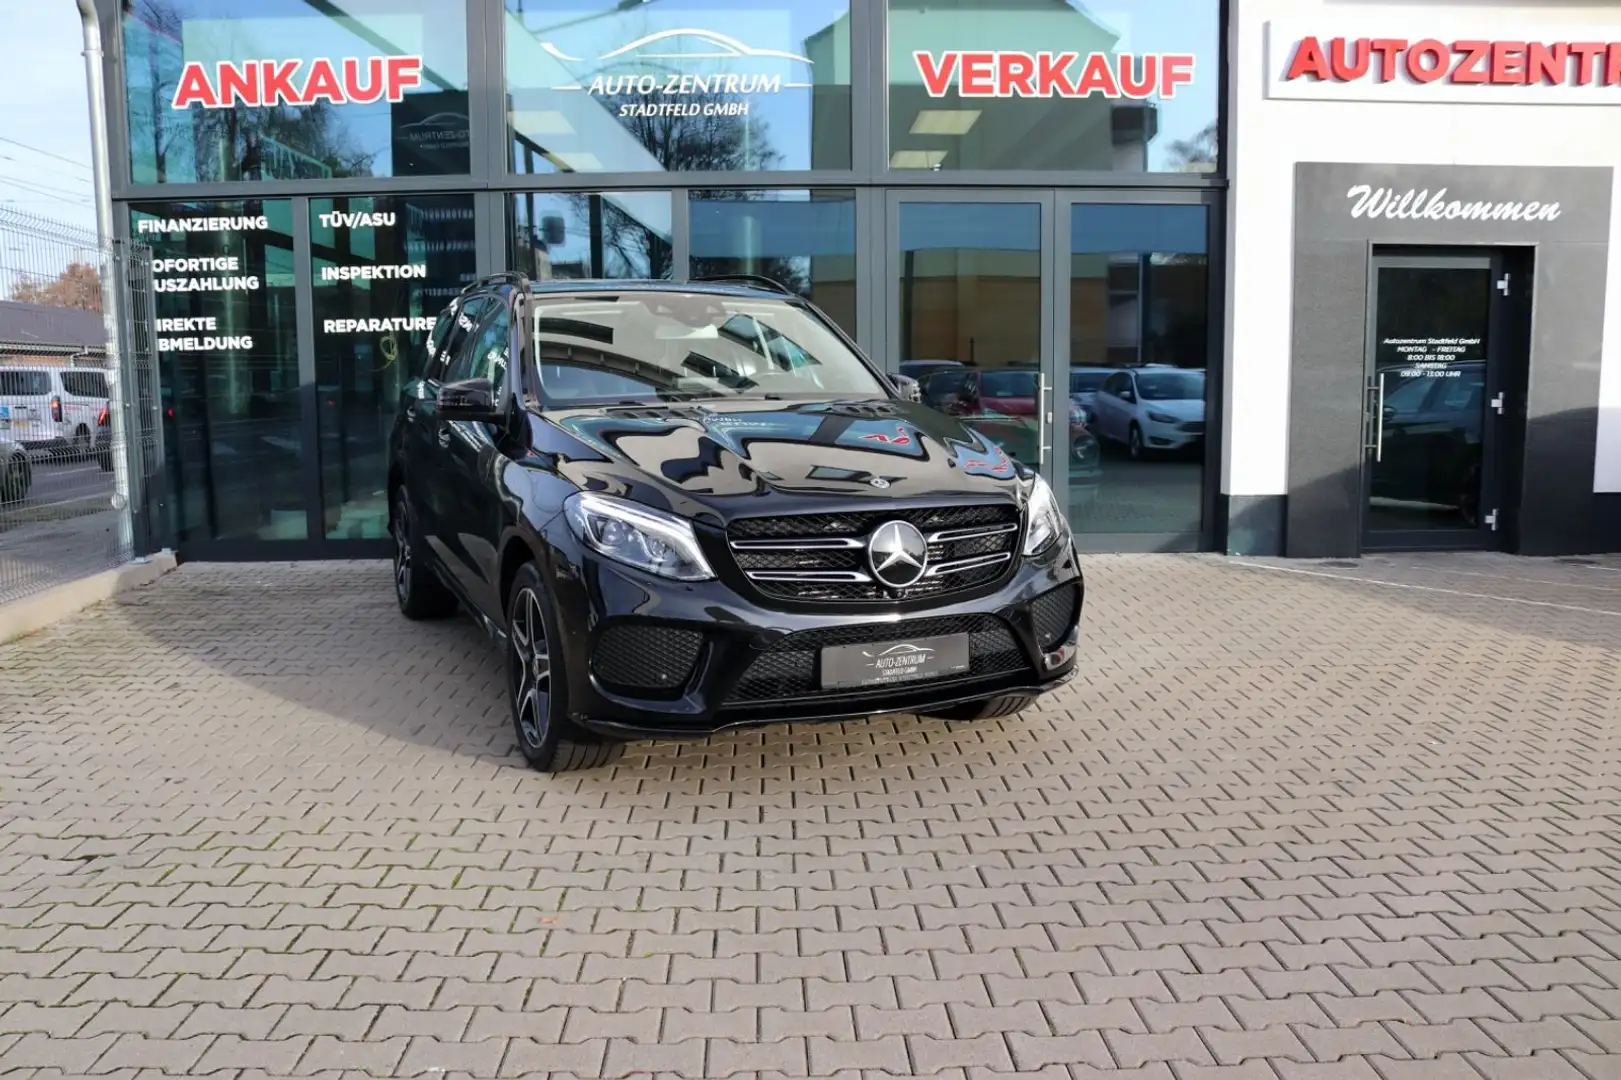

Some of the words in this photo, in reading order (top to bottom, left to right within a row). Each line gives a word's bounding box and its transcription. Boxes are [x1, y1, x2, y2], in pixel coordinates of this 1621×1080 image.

[172, 55, 422, 109] ANKAUF
[914, 50, 1195, 99] VERKAUF
[588, 74, 781, 96] AUTO-ZENTRUM
[619, 104, 700, 117] STADTFELD
[703, 103, 749, 116] GMBH
[1347, 184, 1561, 221] Willkommen
[138, 215, 268, 233] FINANZIERUNG
[320, 212, 396, 229] TÜV/ASU
[152, 257, 239, 272] OFORTIGE
[321, 264, 426, 280] INSPEKTION
[153, 276, 259, 292] USZAHLUNG
[156, 317, 216, 332] IREKTE
[324, 317, 437, 333] REPARATURE
[157, 336, 253, 352] BMELDUNG
[875, 653, 926, 668] AUTO-ZENTRUM
